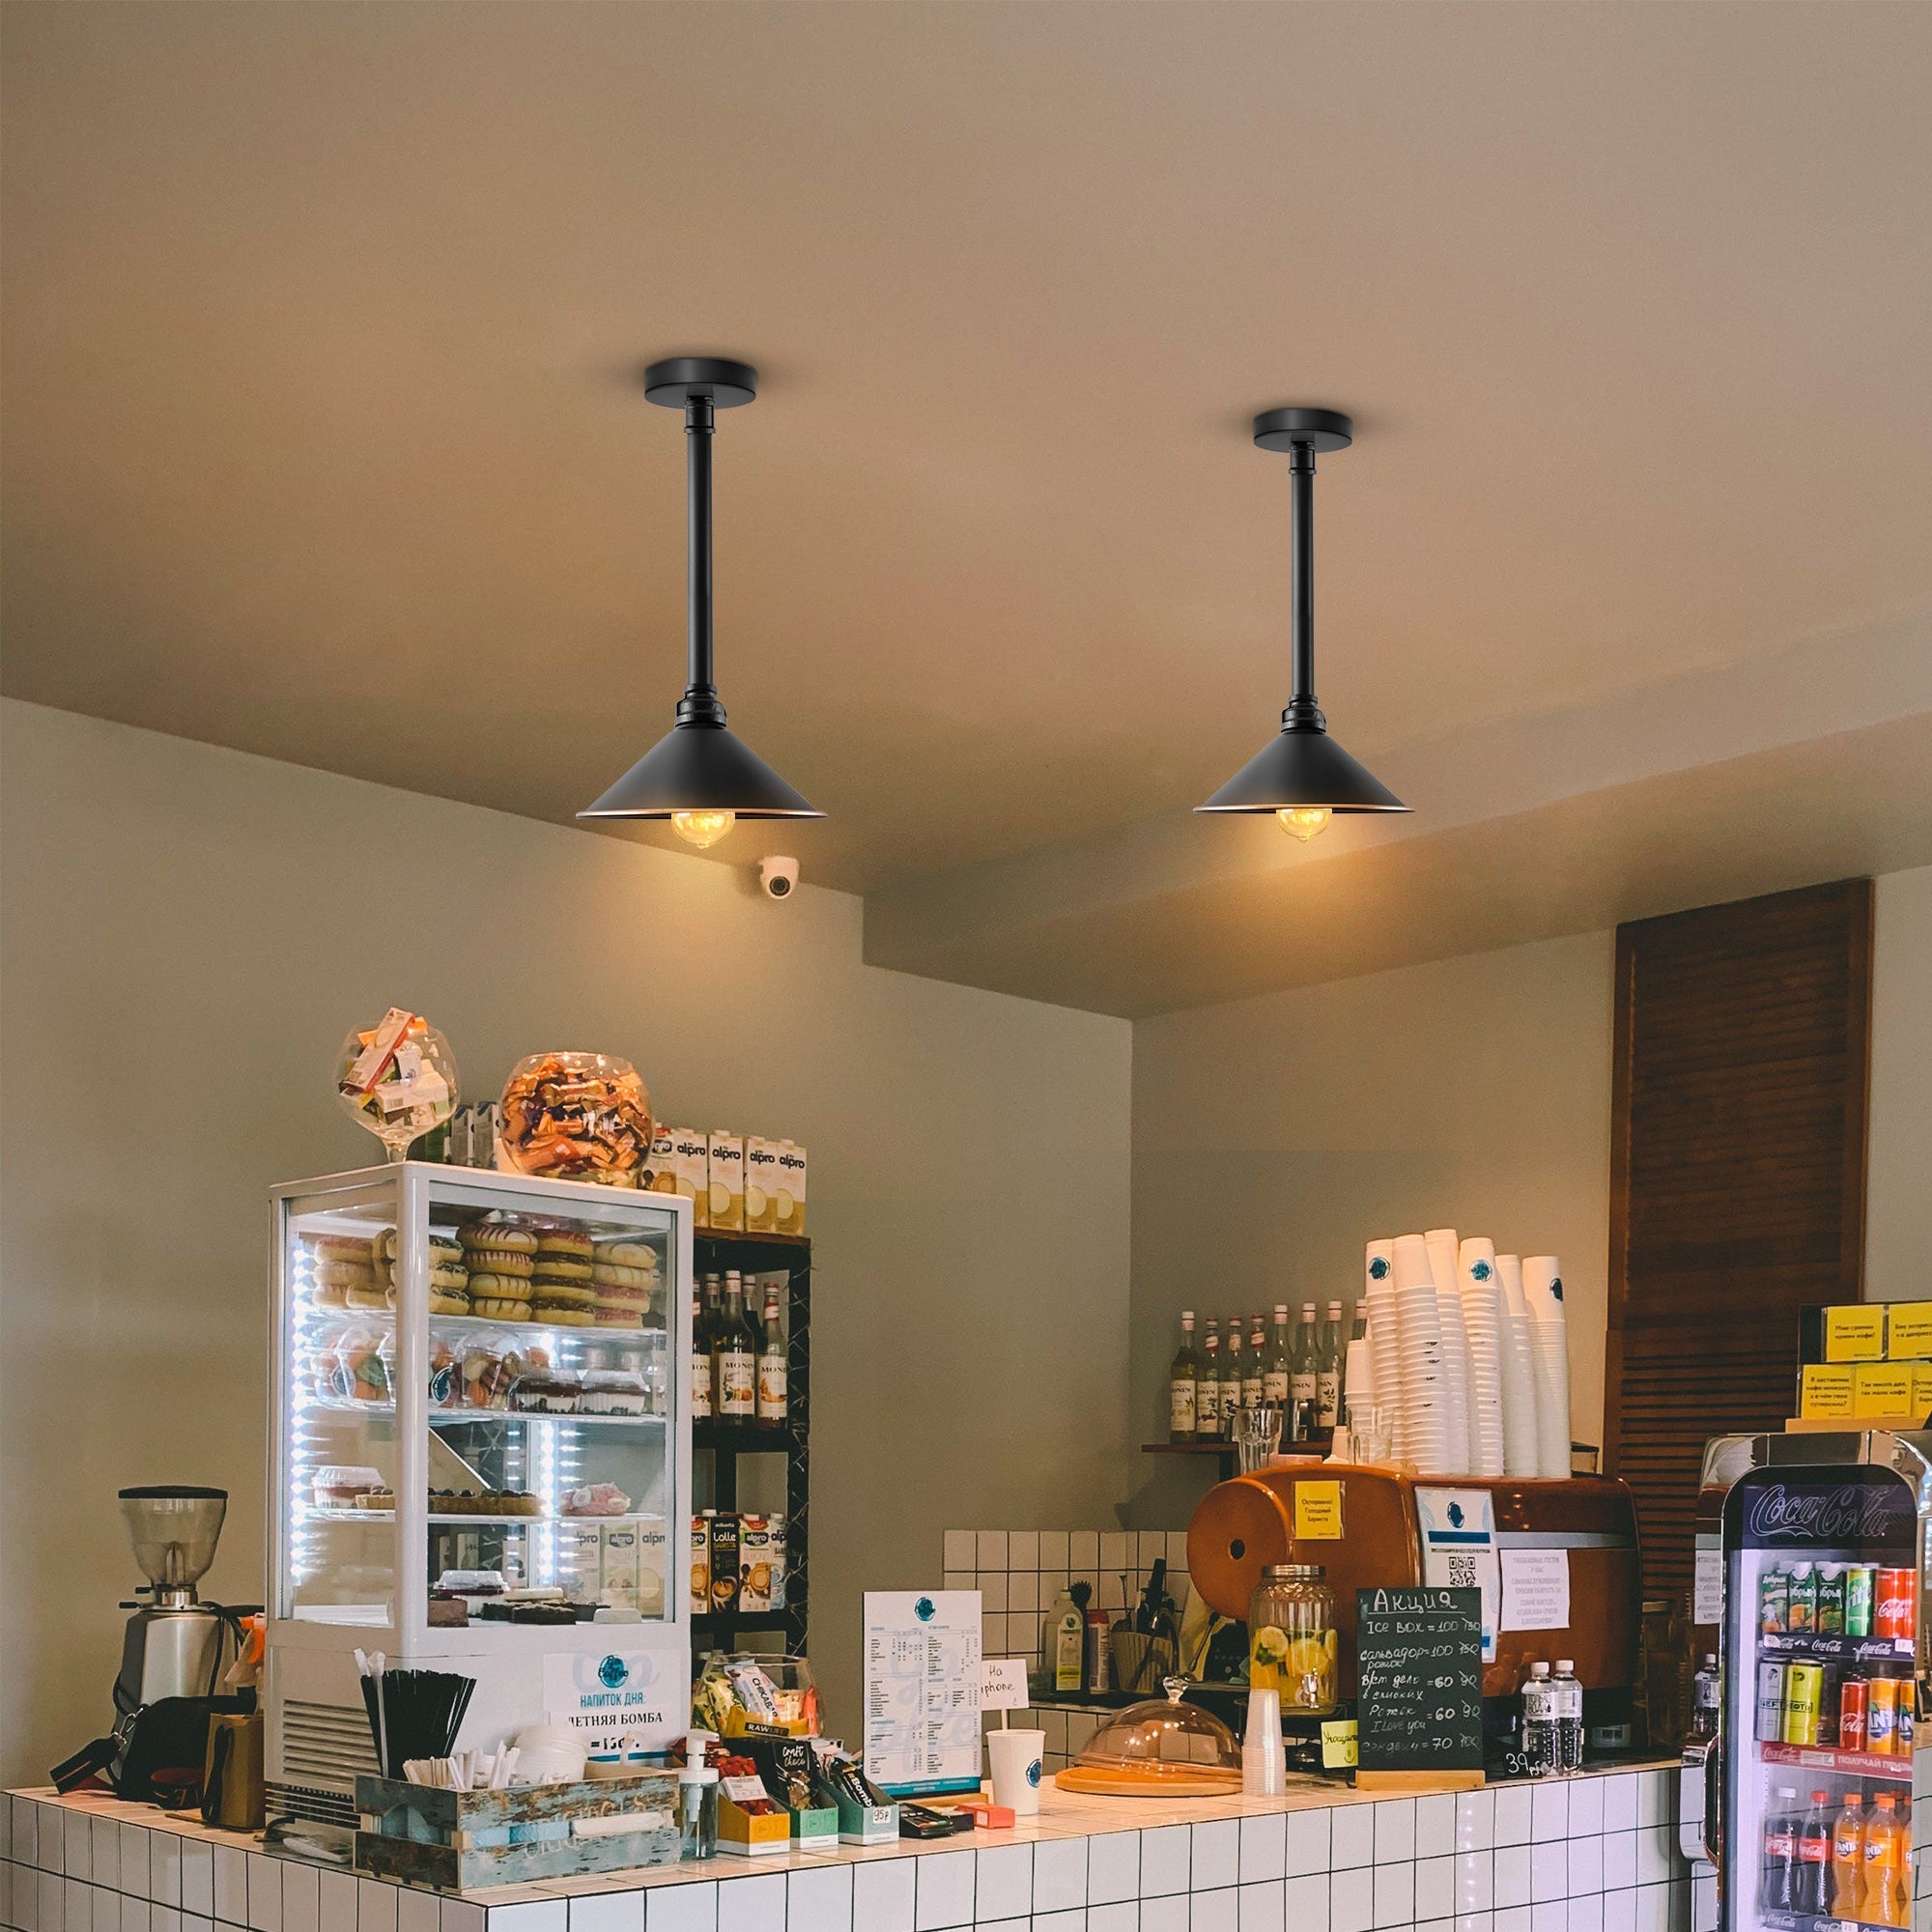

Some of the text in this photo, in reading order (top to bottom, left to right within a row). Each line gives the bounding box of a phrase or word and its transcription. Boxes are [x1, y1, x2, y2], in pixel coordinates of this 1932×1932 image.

[677, 1142, 706, 1157] alpro
[712, 1146, 741, 1161] alpro
[750, 1150, 775, 1165] alpro
[780, 1154, 805, 1169] alpro
[1374, 1588, 1459, 1613] Акция
[581, 1693, 621, 1708] НАПИТОК
[621, 1712, 663, 1725] БОМБА
